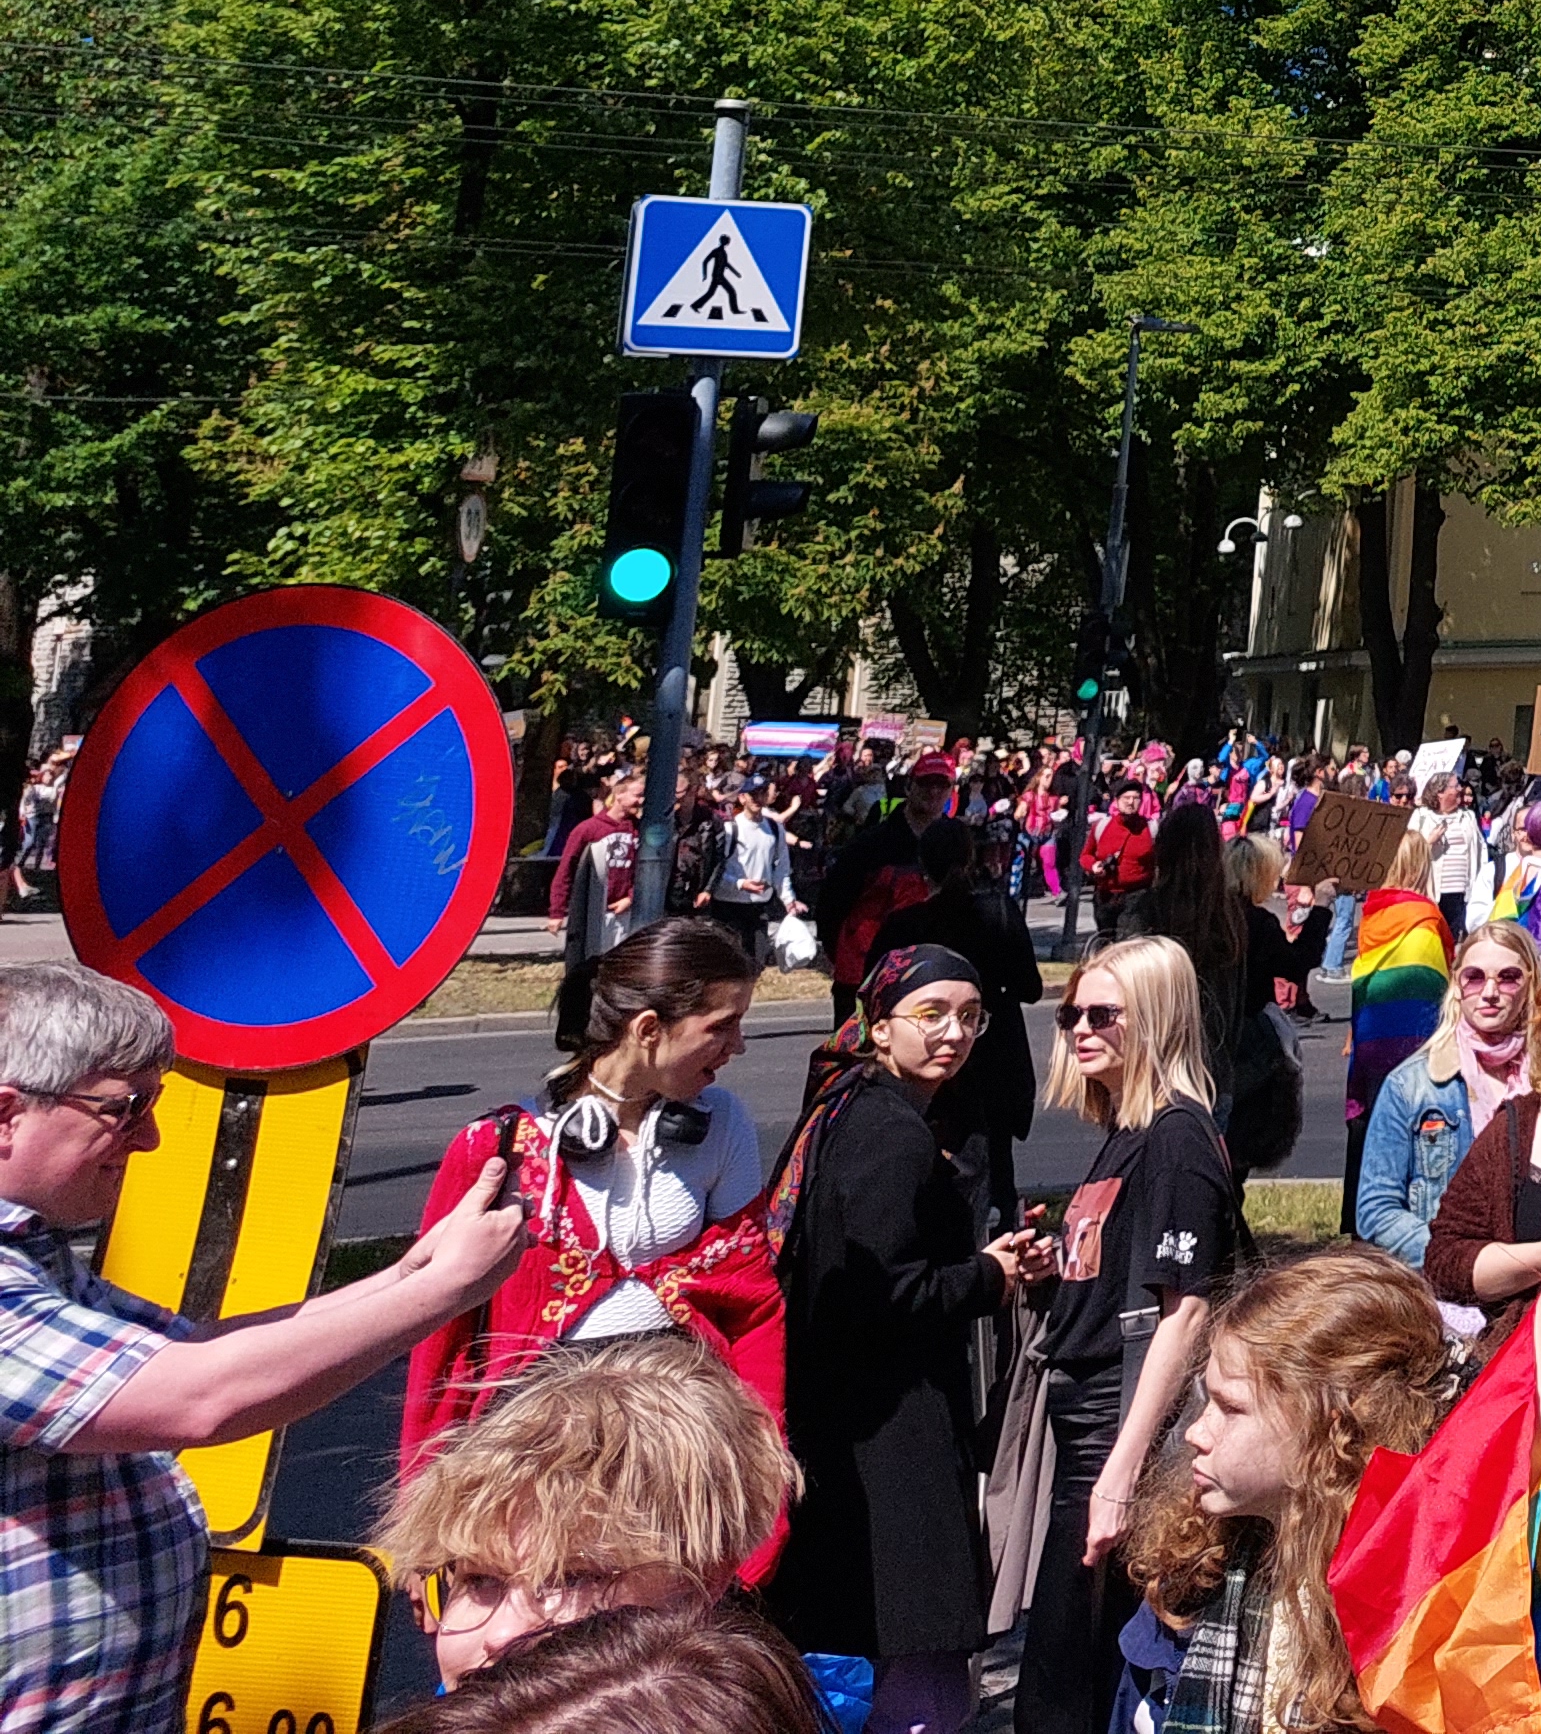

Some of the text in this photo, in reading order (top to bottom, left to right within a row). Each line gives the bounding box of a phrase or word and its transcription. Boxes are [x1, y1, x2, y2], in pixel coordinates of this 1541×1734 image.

[1323, 804, 1401, 841] OUT
[1329, 834, 1371, 857] AND
[1298, 849, 1385, 884] PROUD
